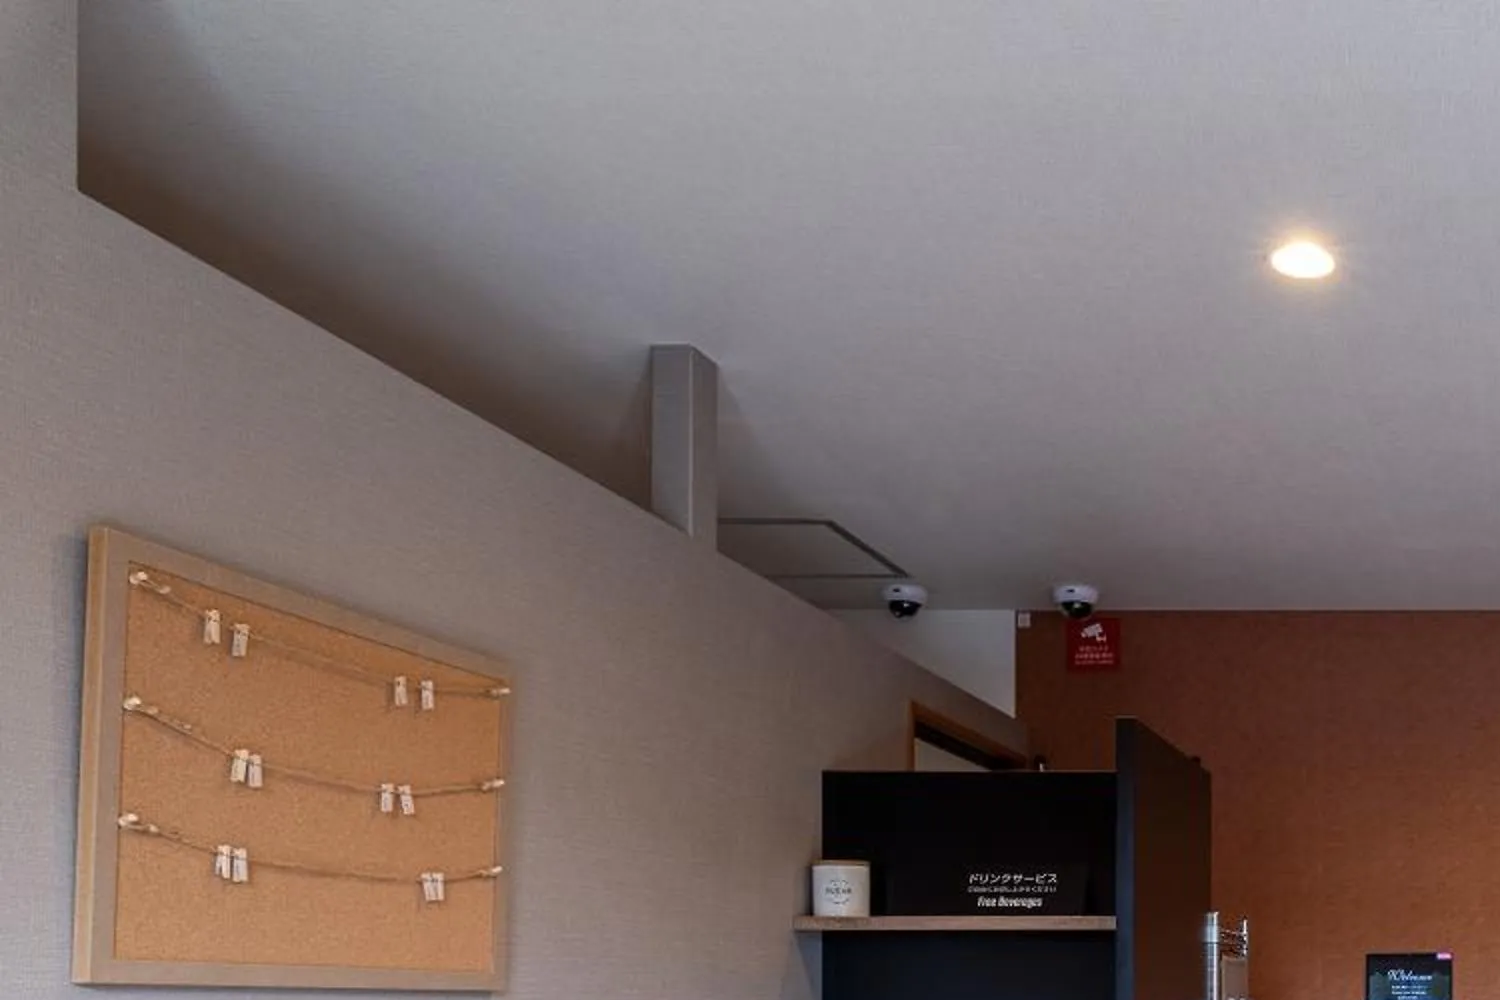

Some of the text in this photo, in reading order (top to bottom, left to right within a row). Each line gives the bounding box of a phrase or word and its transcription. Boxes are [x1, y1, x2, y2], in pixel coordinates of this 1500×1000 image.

[968, 873, 1058, 885] ドリンクサービス
[977, 895, 1043, 909] Free Beverages
